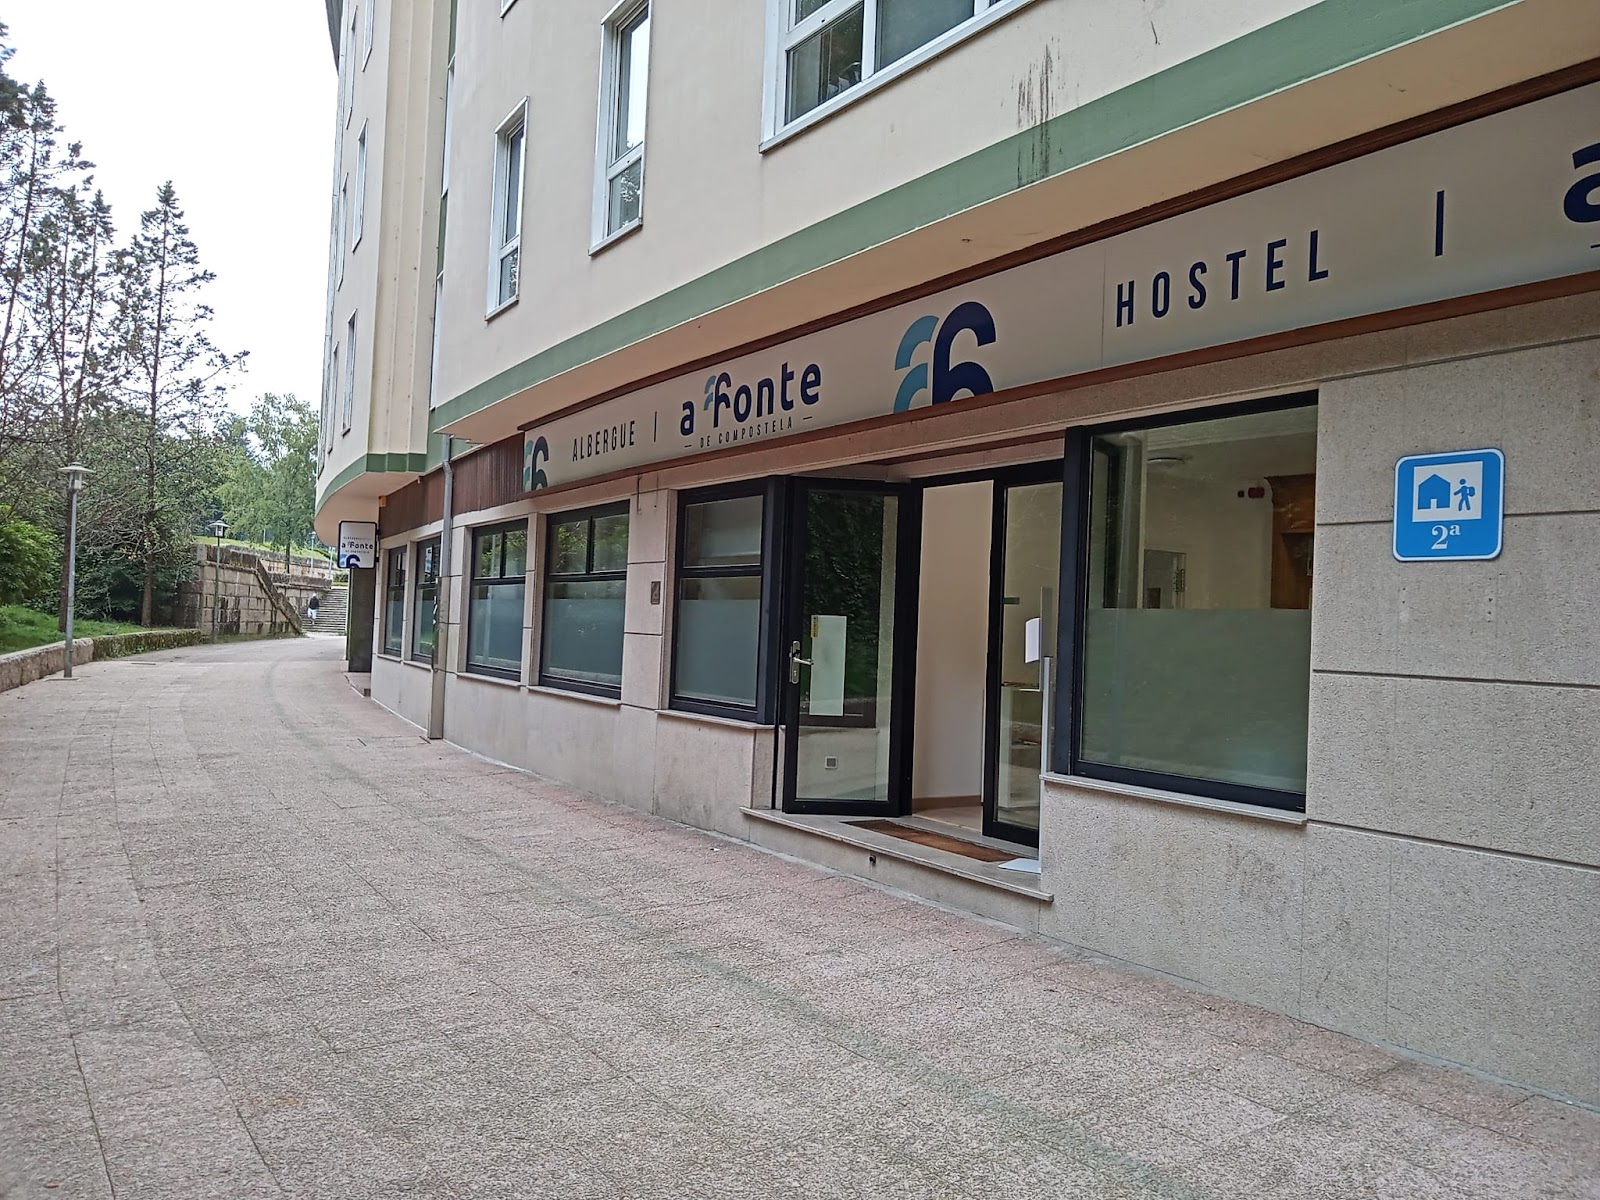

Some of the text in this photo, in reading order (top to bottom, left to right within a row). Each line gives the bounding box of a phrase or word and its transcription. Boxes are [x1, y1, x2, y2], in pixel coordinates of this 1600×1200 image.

[1116, 229, 1329, 328] HOSTEL
[680, 400, 695, 436] a
[700, 416, 793, 449] DE COMPOSTELA
[572, 420, 635, 462] ALBERGUE
